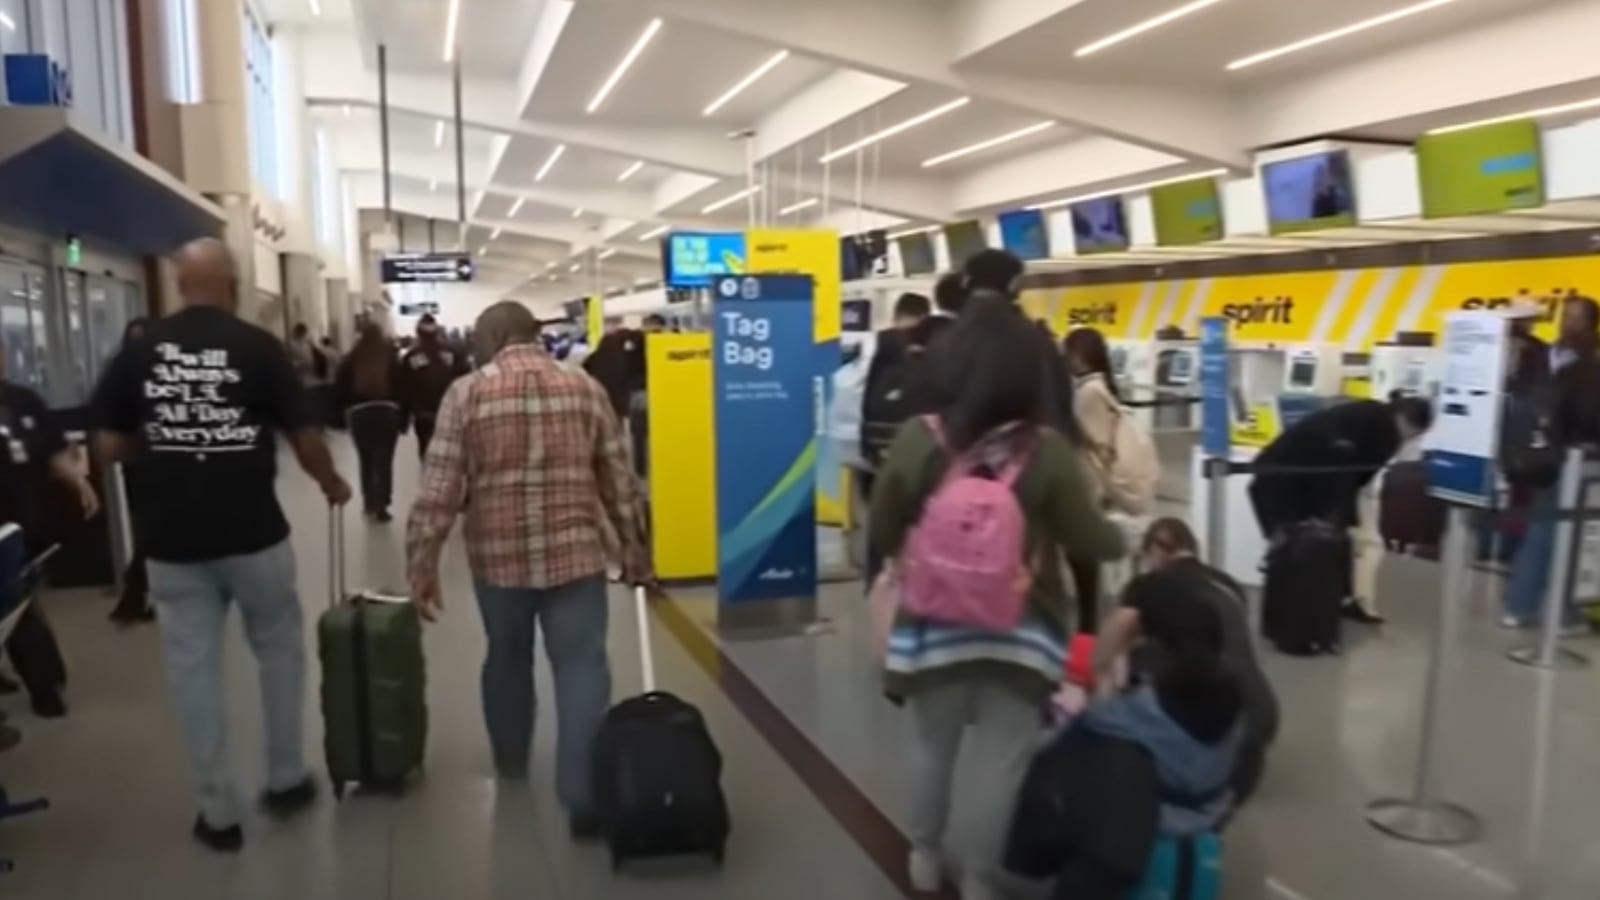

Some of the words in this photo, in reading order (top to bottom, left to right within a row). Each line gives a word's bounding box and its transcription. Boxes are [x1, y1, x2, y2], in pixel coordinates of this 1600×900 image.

[1068, 302, 1118, 325] spirit
[1222, 296, 1293, 330] spirit
[722, 312, 771, 341] Tag
[181, 349, 228, 366] will
[724, 340, 773, 369] Bag
[144, 381, 180, 398] be
[155, 403, 189, 422] All
[191, 404, 245, 425] Day
[145, 422, 262, 446] Everyday
